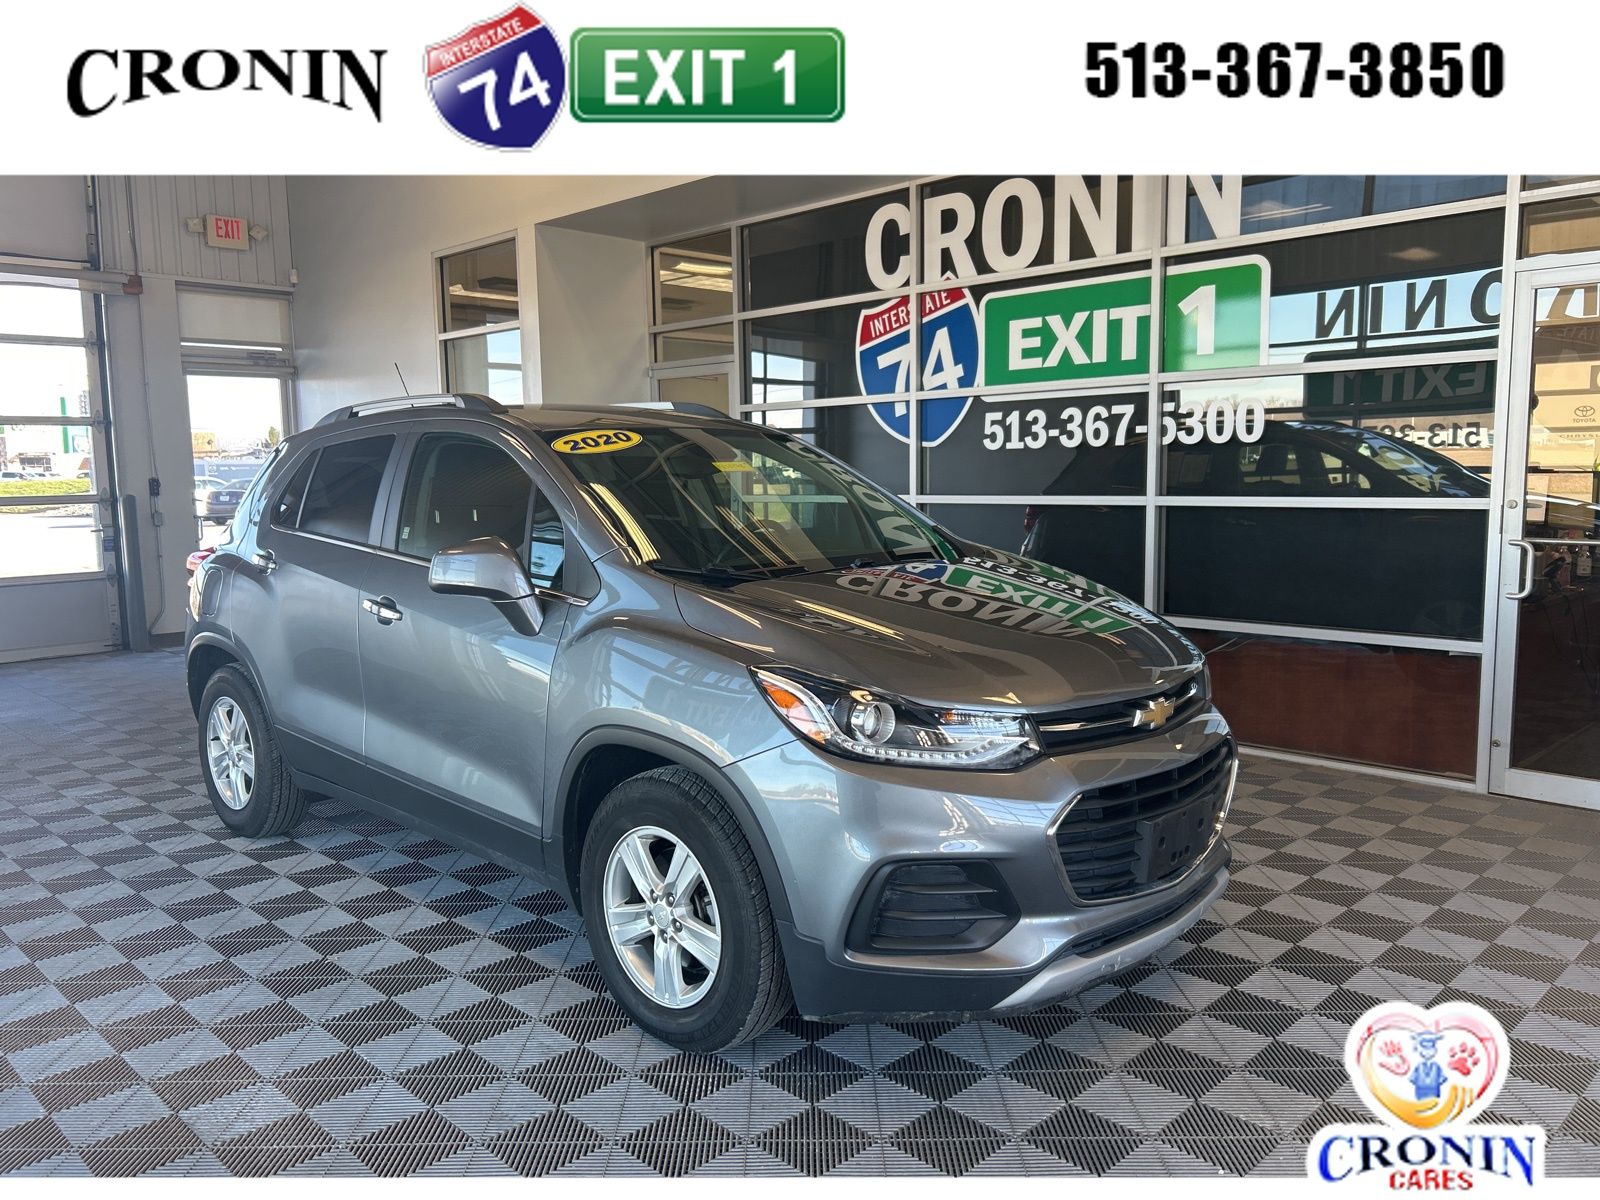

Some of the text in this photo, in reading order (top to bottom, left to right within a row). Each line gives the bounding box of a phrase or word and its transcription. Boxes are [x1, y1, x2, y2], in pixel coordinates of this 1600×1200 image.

[215, 217, 241, 240] EXIT
[865, 174, 1242, 291] CRONIN
[869, 291, 951, 338] INTERATE
[1008, 284, 1216, 371] EXIT 1
[876, 325, 964, 418] 74
[562, 432, 633, 452] 2020
[982, 398, 1266, 450] 513-367-5300
